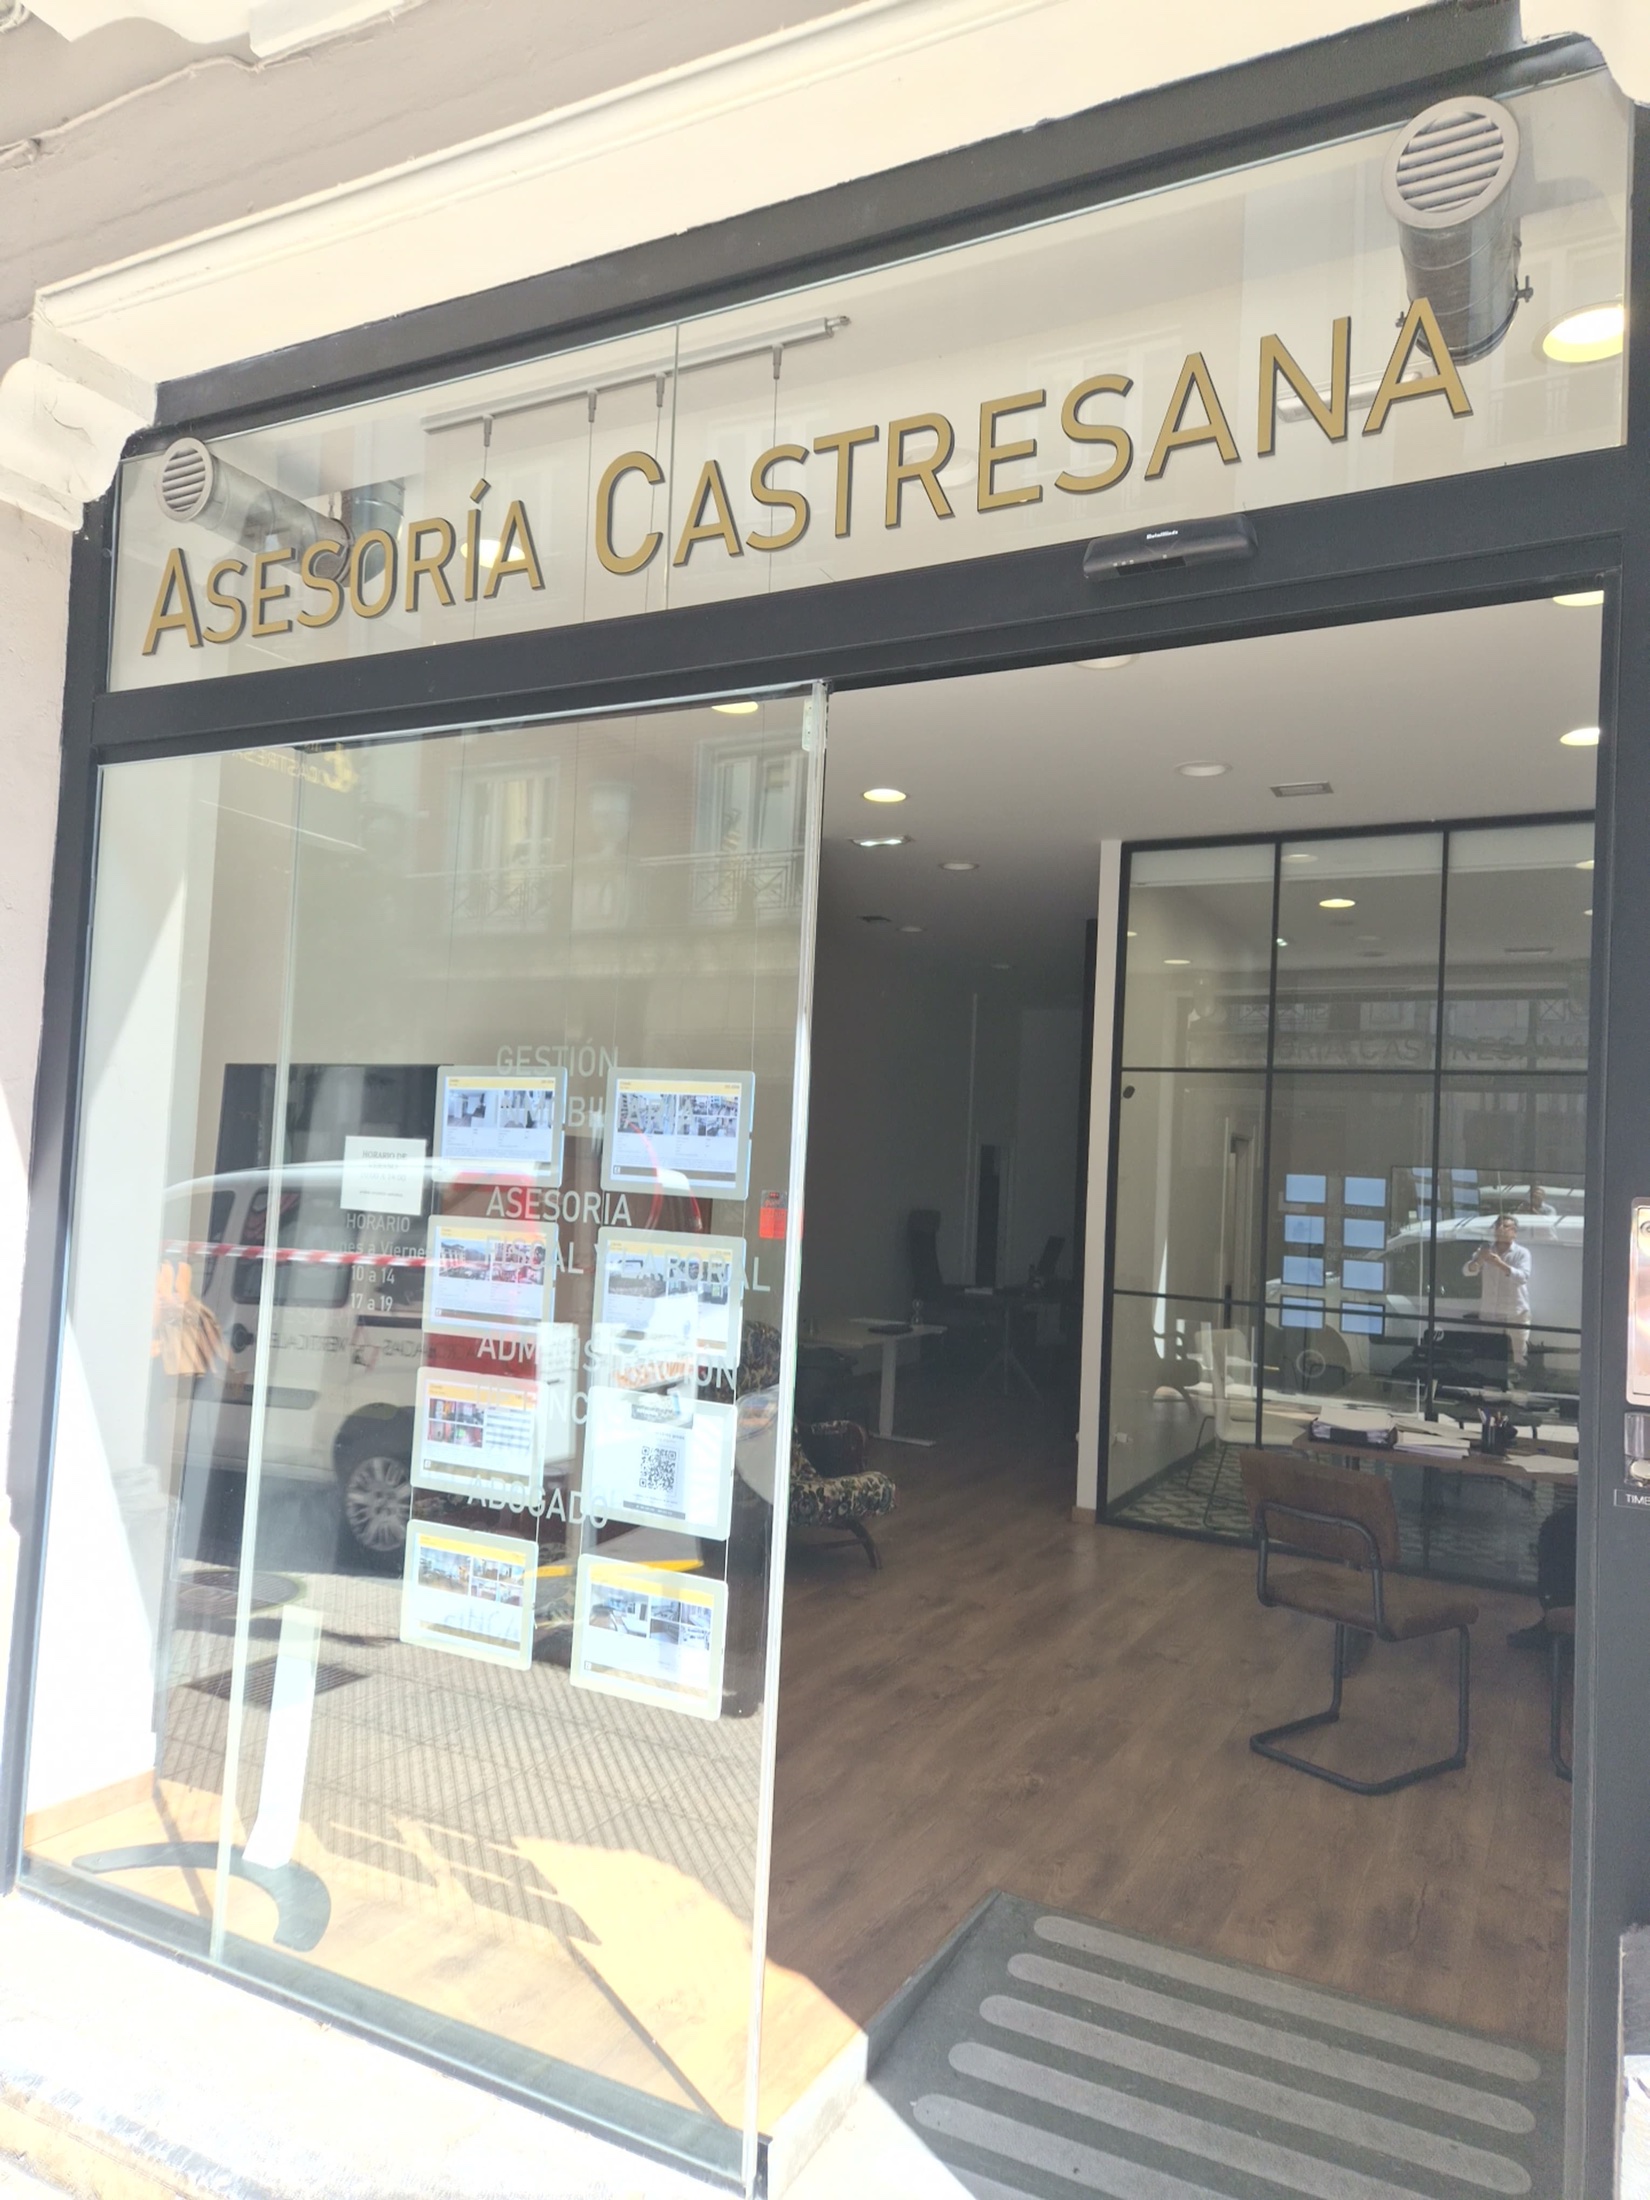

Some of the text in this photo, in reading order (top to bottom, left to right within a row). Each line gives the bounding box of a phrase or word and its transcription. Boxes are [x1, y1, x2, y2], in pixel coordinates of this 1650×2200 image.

[141, 297, 1474, 657] ASESORÍA CASTRESANA
[496, 1038, 619, 1077] GESTIÓN
[486, 1185, 633, 1227] ASESORIA
[346, 1213, 411, 1233] HORARIO
[350, 1264, 396, 1285] 10 a 14
[350, 1292, 394, 1313] 17 a 19
